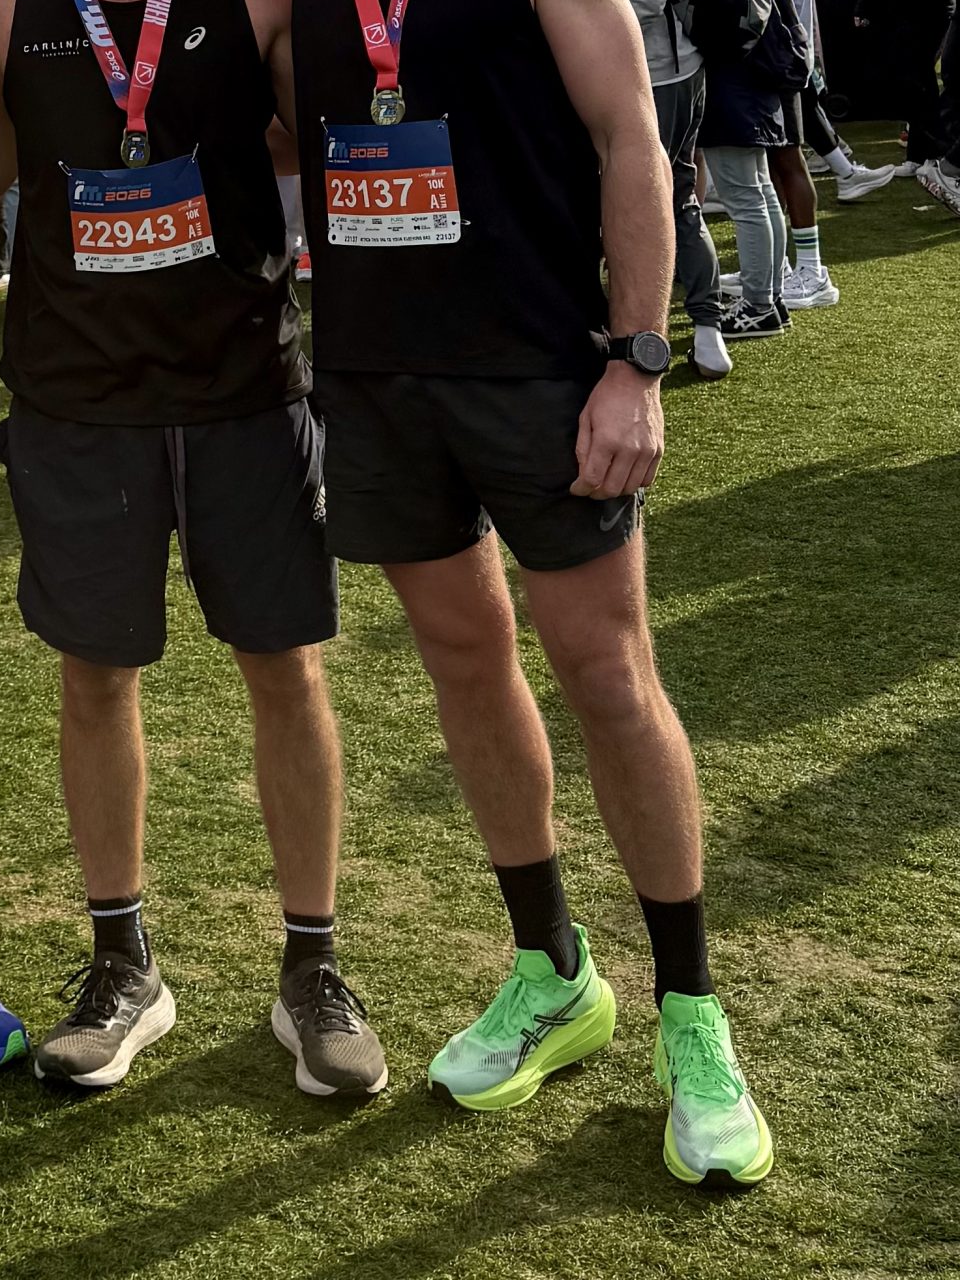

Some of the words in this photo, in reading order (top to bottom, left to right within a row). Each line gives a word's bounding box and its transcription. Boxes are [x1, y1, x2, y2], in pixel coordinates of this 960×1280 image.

[105, 50, 120, 74] asics
[350, 147, 389, 158] 2026
[427, 178, 445, 190] 10K
[105, 187, 153, 202] 2026
[331, 177, 414, 208] 23137
[185, 208, 200, 220] 10K
[78, 214, 177, 248] 22943
